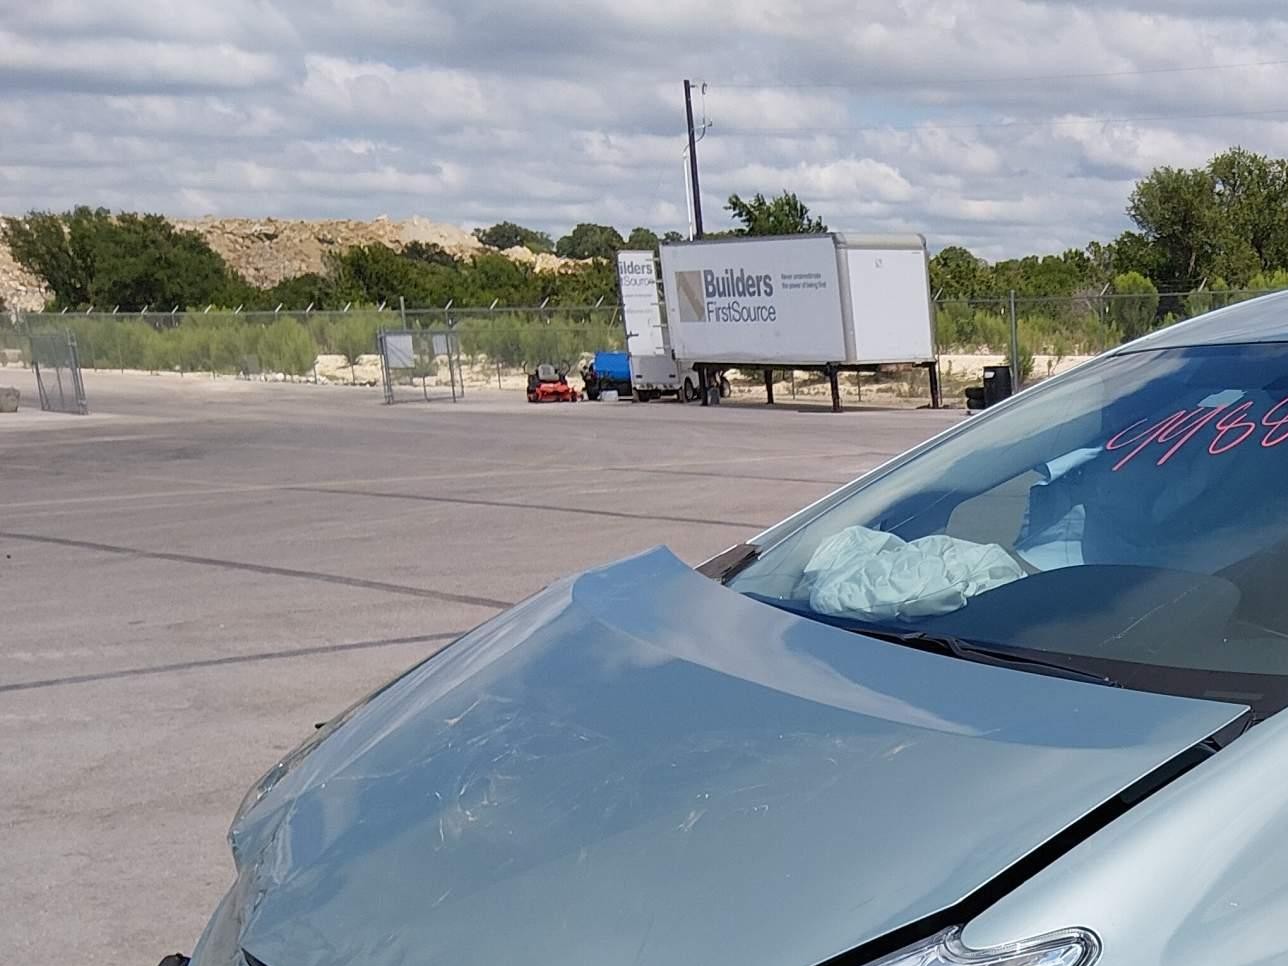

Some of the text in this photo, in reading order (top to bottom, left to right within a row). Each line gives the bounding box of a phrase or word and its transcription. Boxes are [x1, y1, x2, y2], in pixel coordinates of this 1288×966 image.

[620, 261, 653, 275] ilders
[704, 268, 773, 298] Builders
[707, 301, 777, 322] FirstSource
